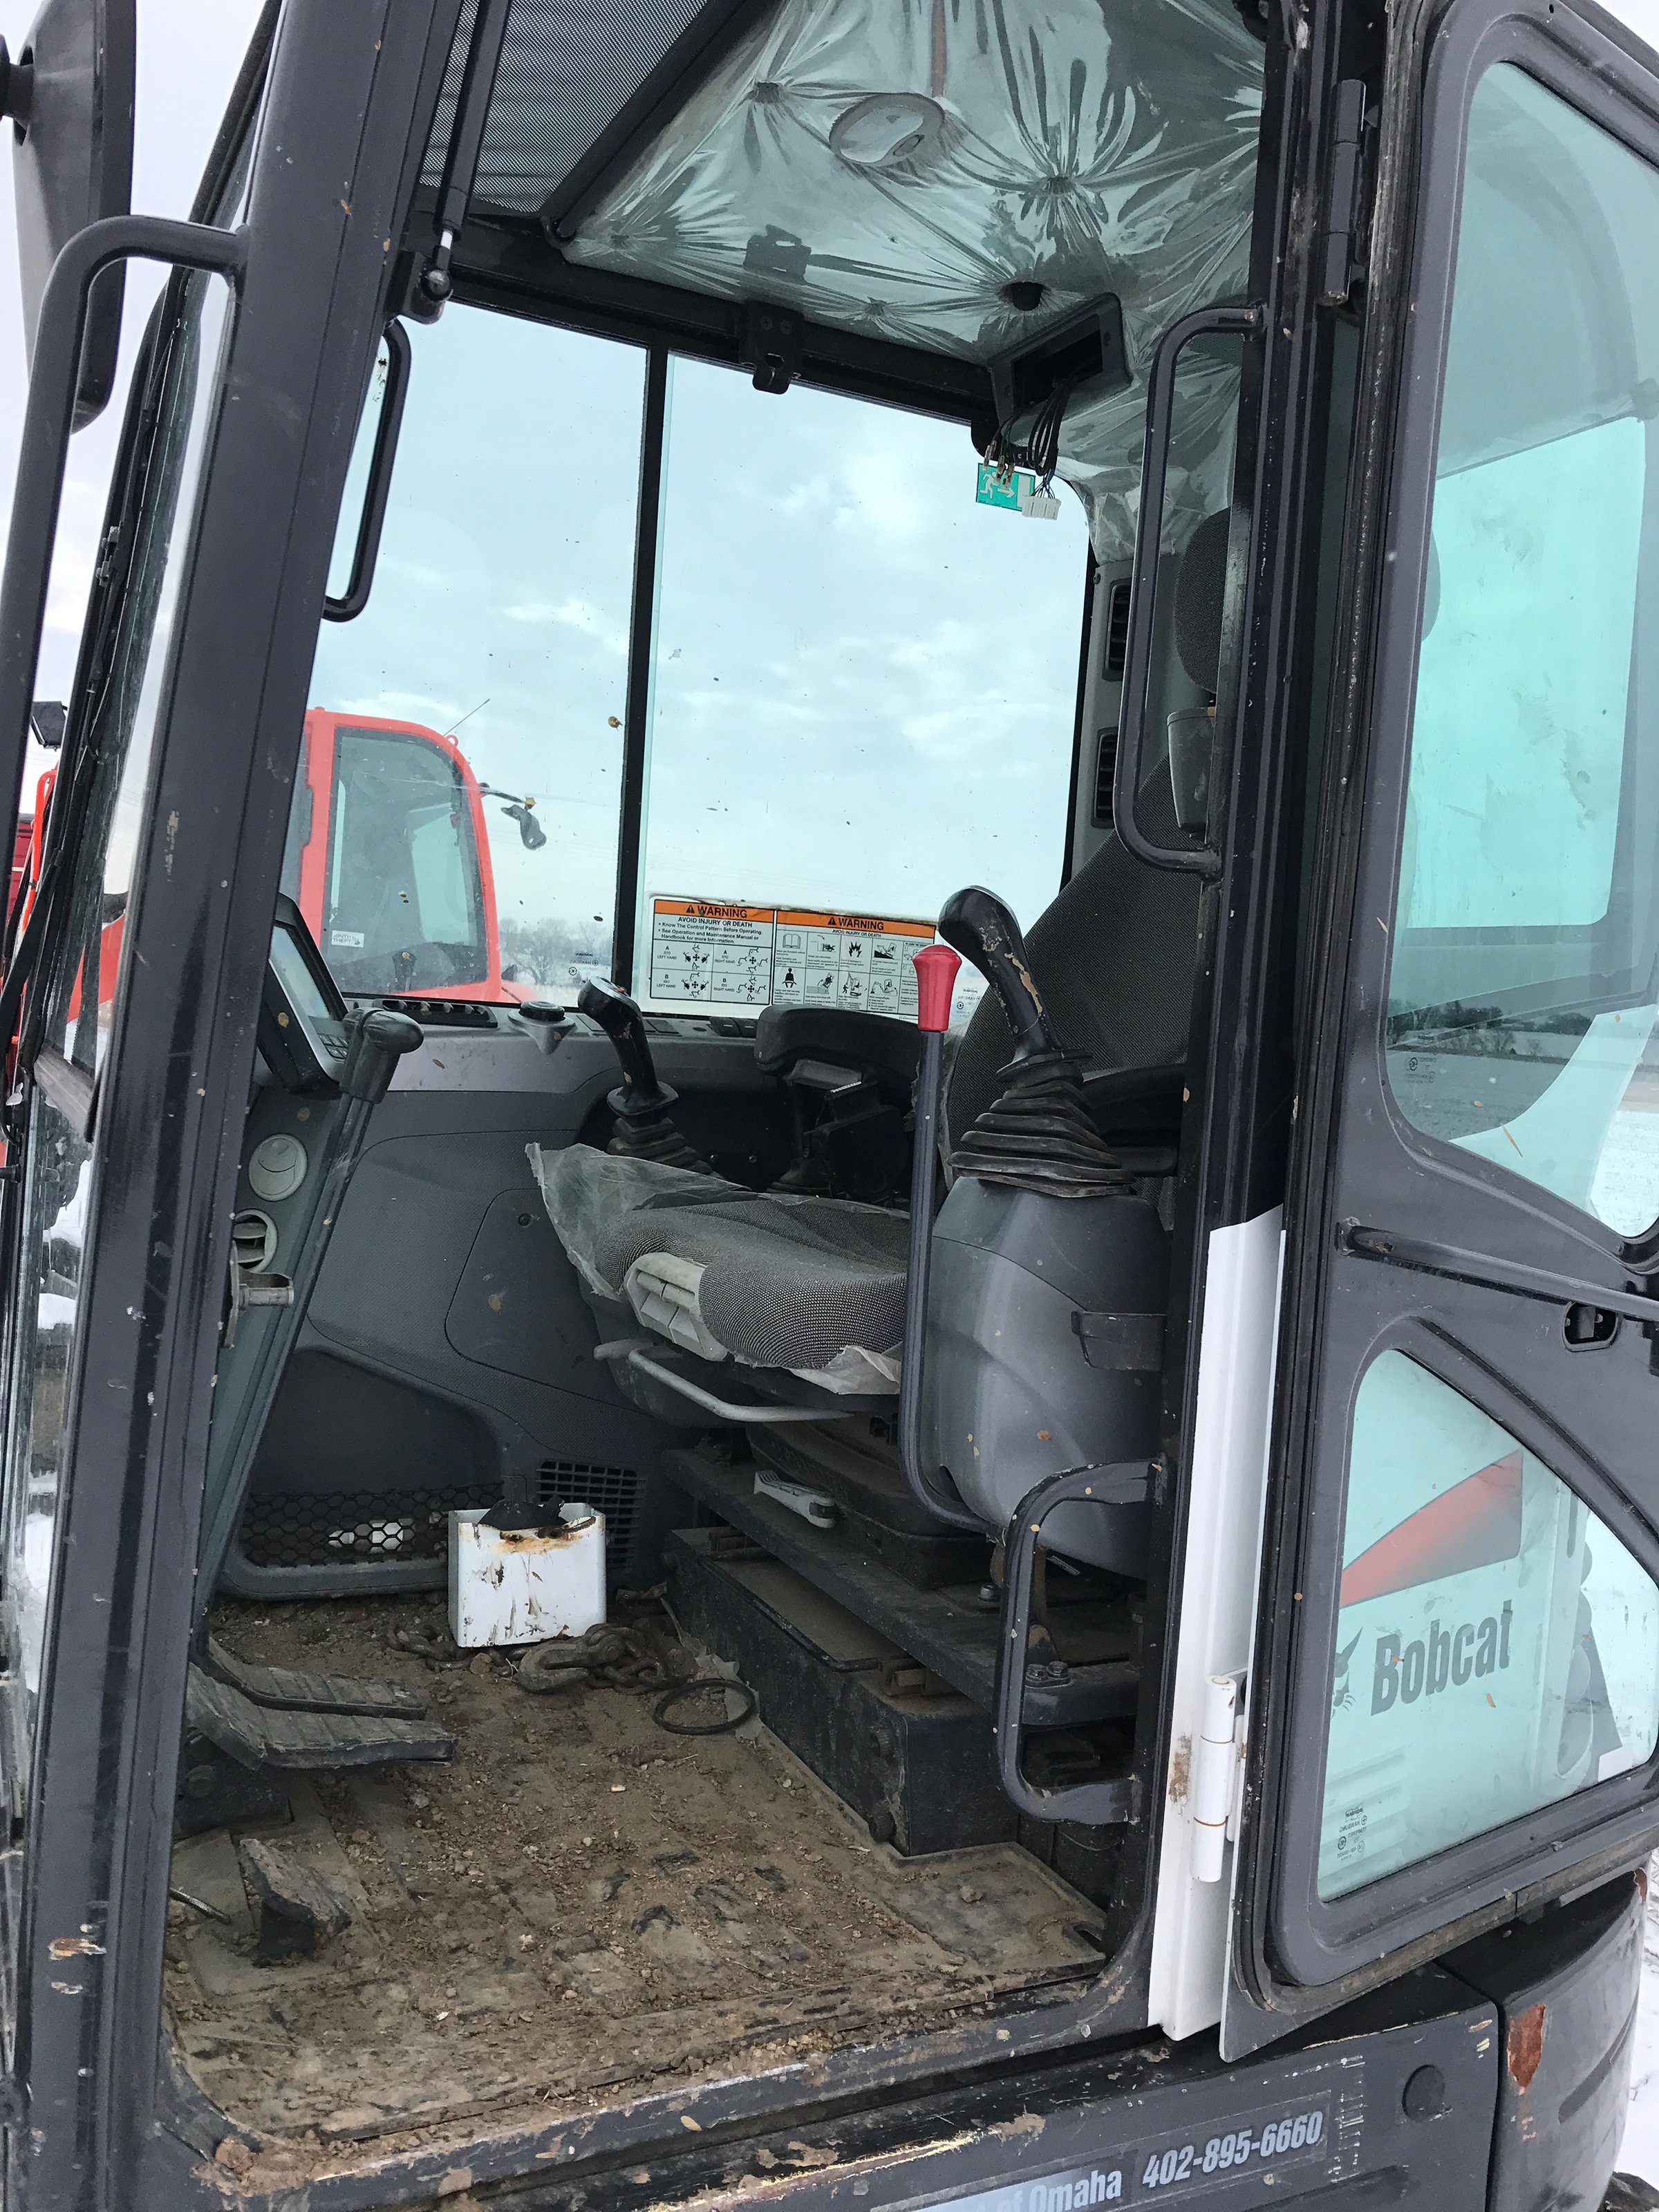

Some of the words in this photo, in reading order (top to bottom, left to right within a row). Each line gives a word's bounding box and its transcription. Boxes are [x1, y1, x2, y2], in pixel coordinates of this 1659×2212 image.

[697, 906, 747, 919] WARNING
[838, 917, 884, 930] WARNING
[1371, 1599, 1513, 1716] Bobcat
[1142, 2111, 1323, 2188] 402-895-6660
[1029, 2169, 1122, 2212] Omaha
